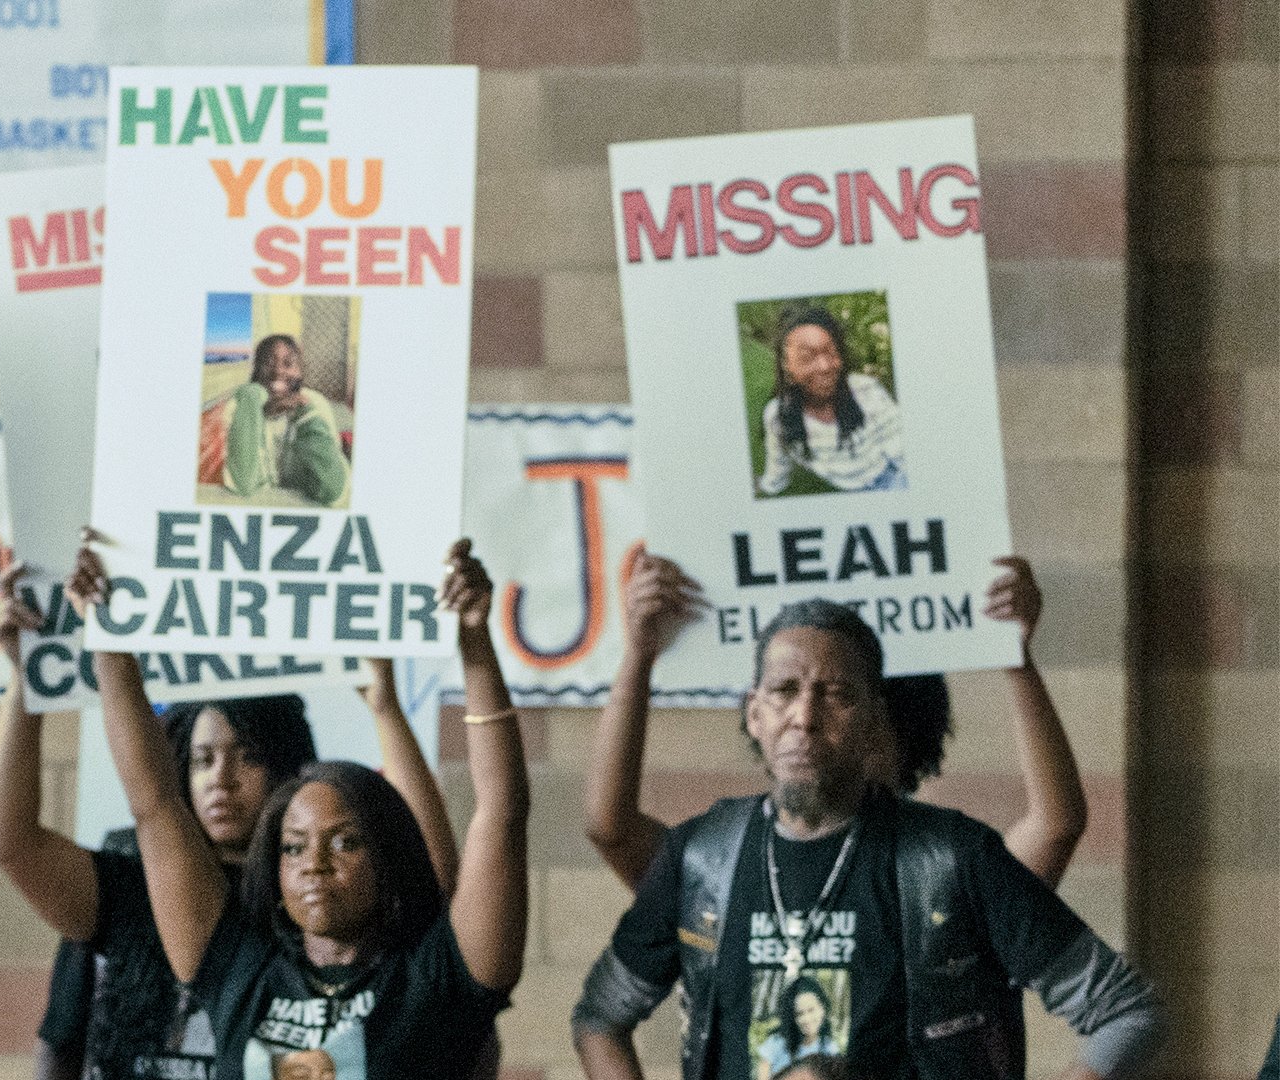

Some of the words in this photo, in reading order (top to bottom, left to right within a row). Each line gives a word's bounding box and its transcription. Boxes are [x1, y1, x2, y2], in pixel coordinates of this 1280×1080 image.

[118, 84, 330, 147] HAVE
[209, 158, 383, 219] YOU
[620, 163, 983, 264] MISSING
[252, 225, 463, 287] SEEN
[155, 511, 384, 574] ENZA
[731, 518, 948, 588] LEAH
[95, 577, 440, 642] CARTER
